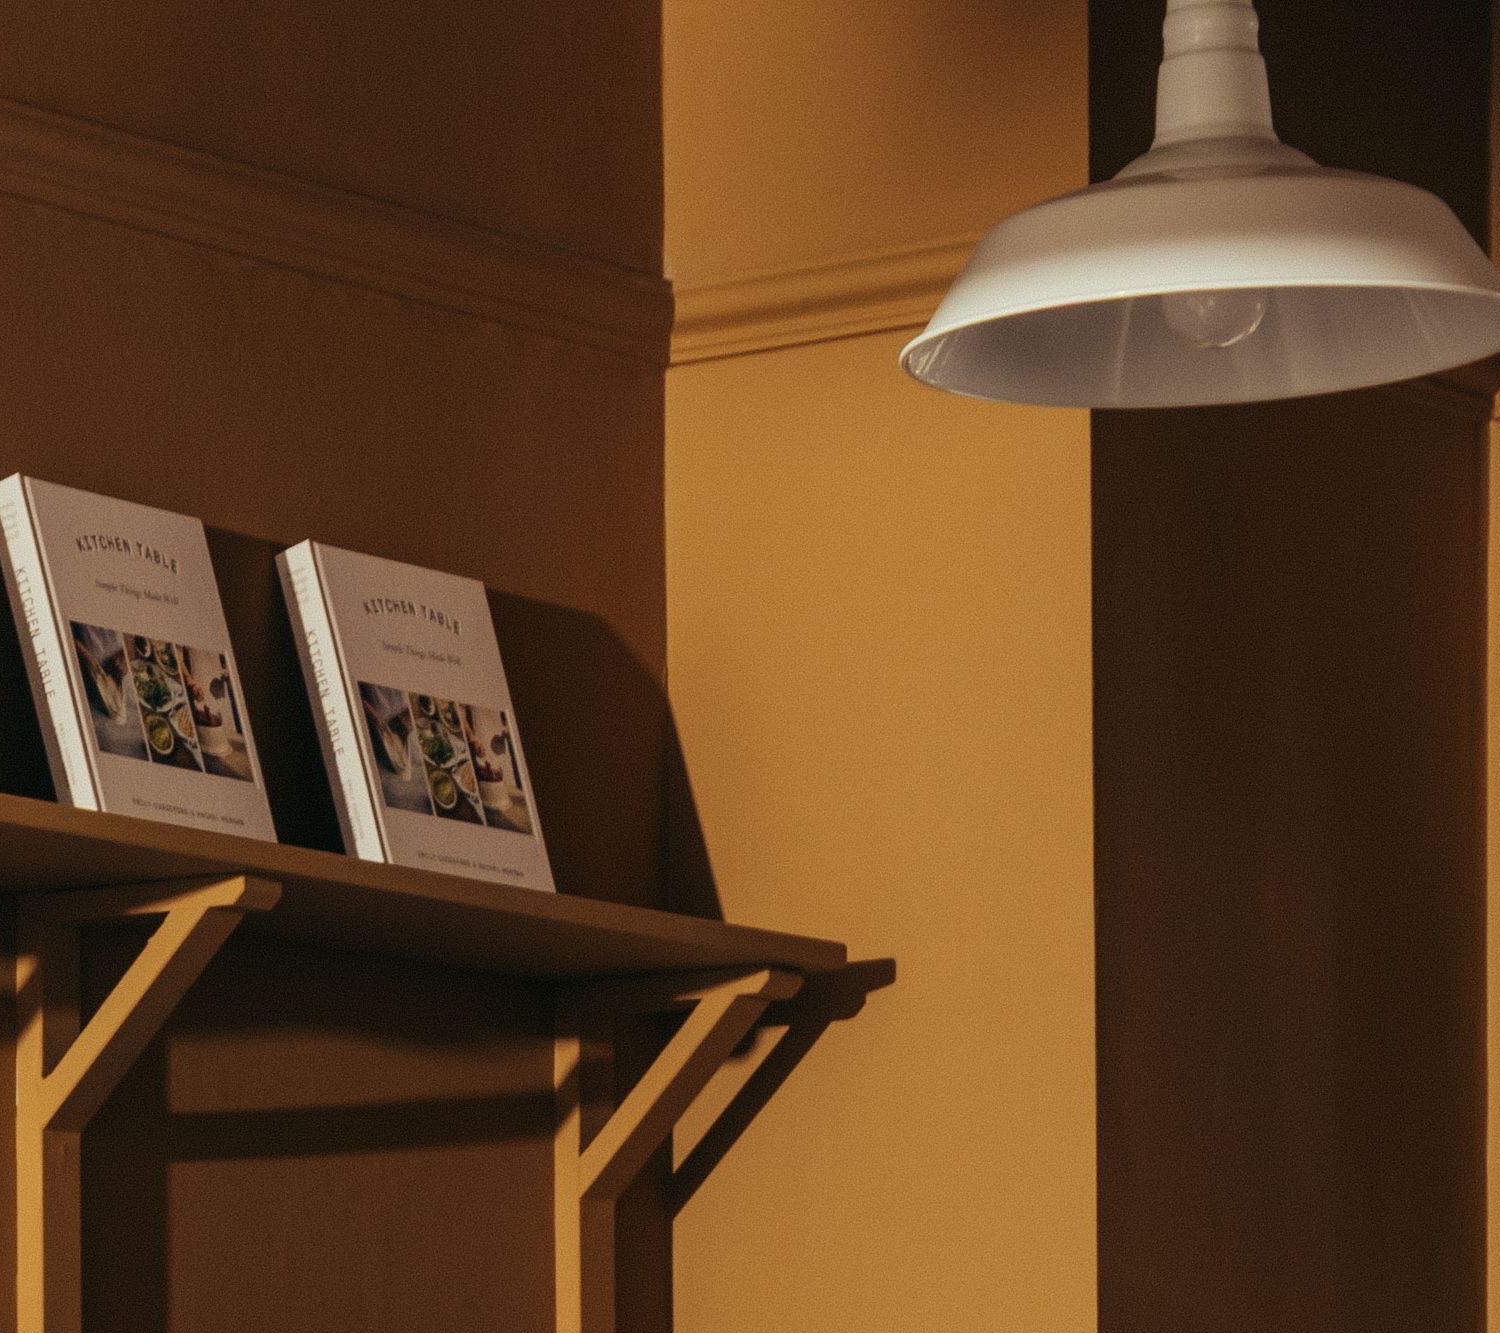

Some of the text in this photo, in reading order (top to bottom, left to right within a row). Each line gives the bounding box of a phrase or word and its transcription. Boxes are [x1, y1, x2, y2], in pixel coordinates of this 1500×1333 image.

[75, 535, 179, 574] KITCHEN TABLE
[16, 566, 41, 638] KITCHEN
[363, 599, 460, 636] KITCHEN TABLE
[306, 630, 331, 700] KITCHEN
